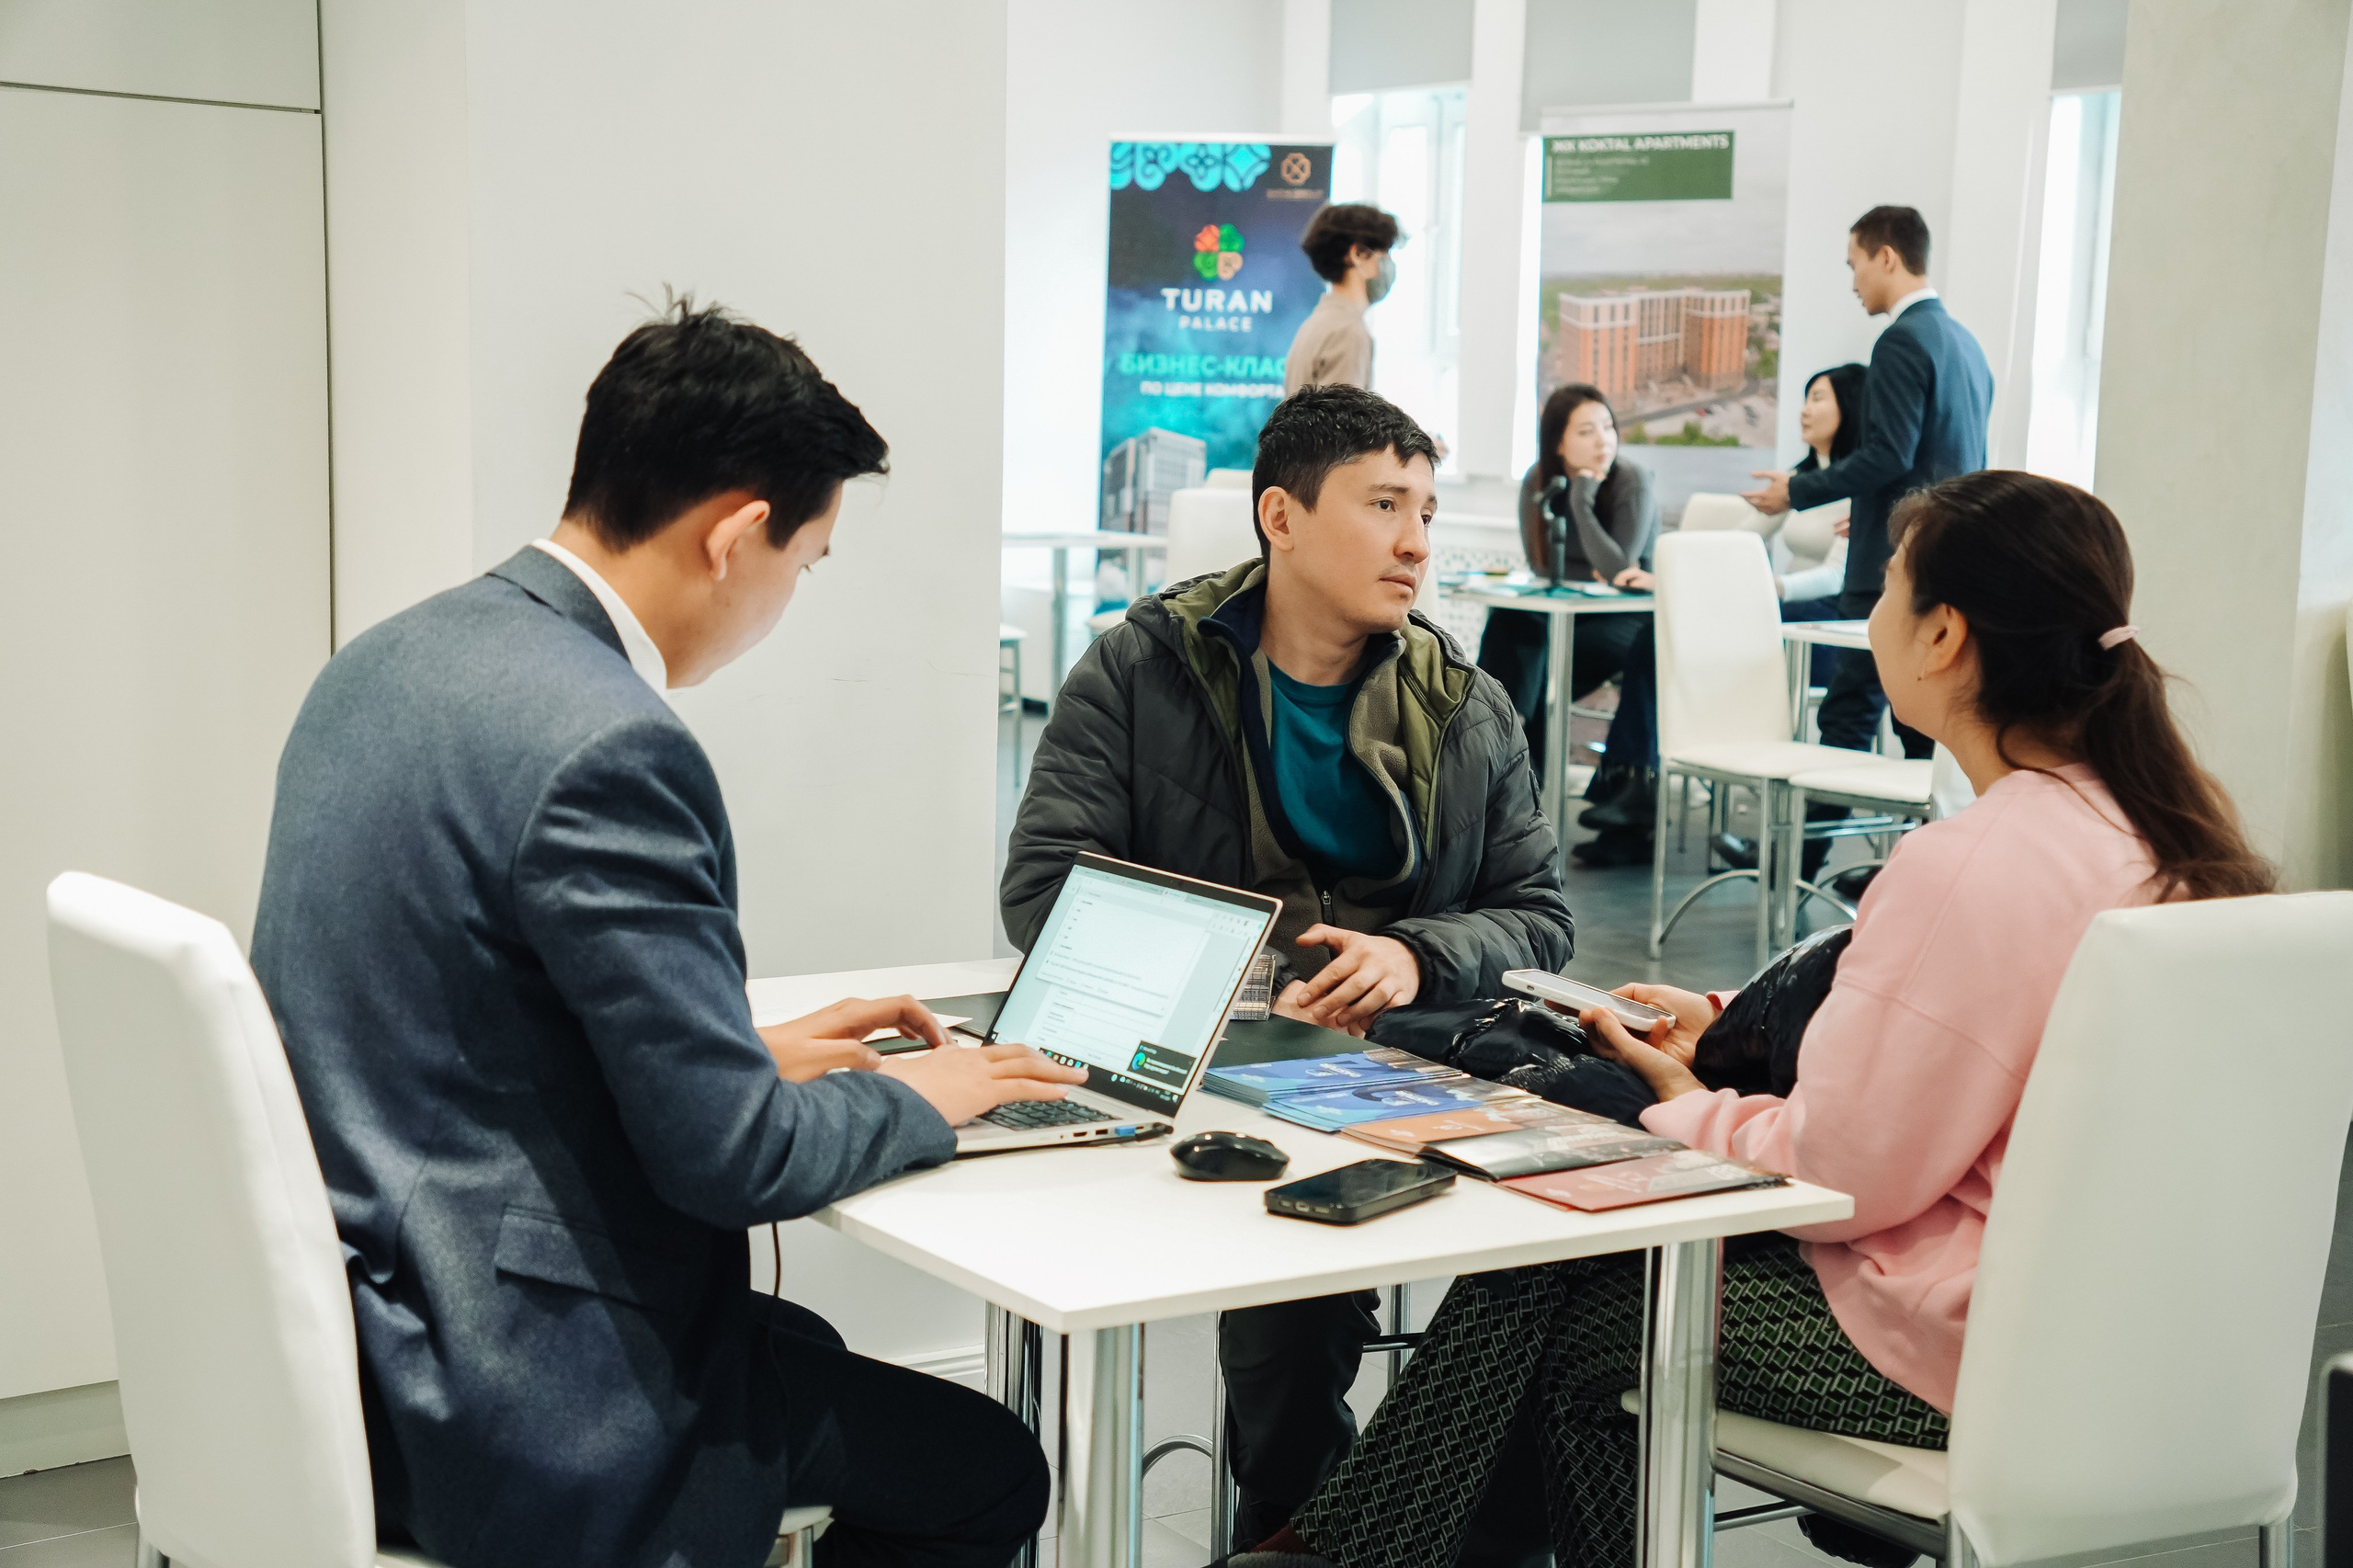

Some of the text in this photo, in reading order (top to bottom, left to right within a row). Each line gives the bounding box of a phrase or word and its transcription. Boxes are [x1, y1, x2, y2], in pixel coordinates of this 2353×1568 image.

[1634, 135, 1730, 150] APARTMENTS
[1161, 288, 1273, 313] TURAN
[1179, 315, 1253, 332] PALACE
